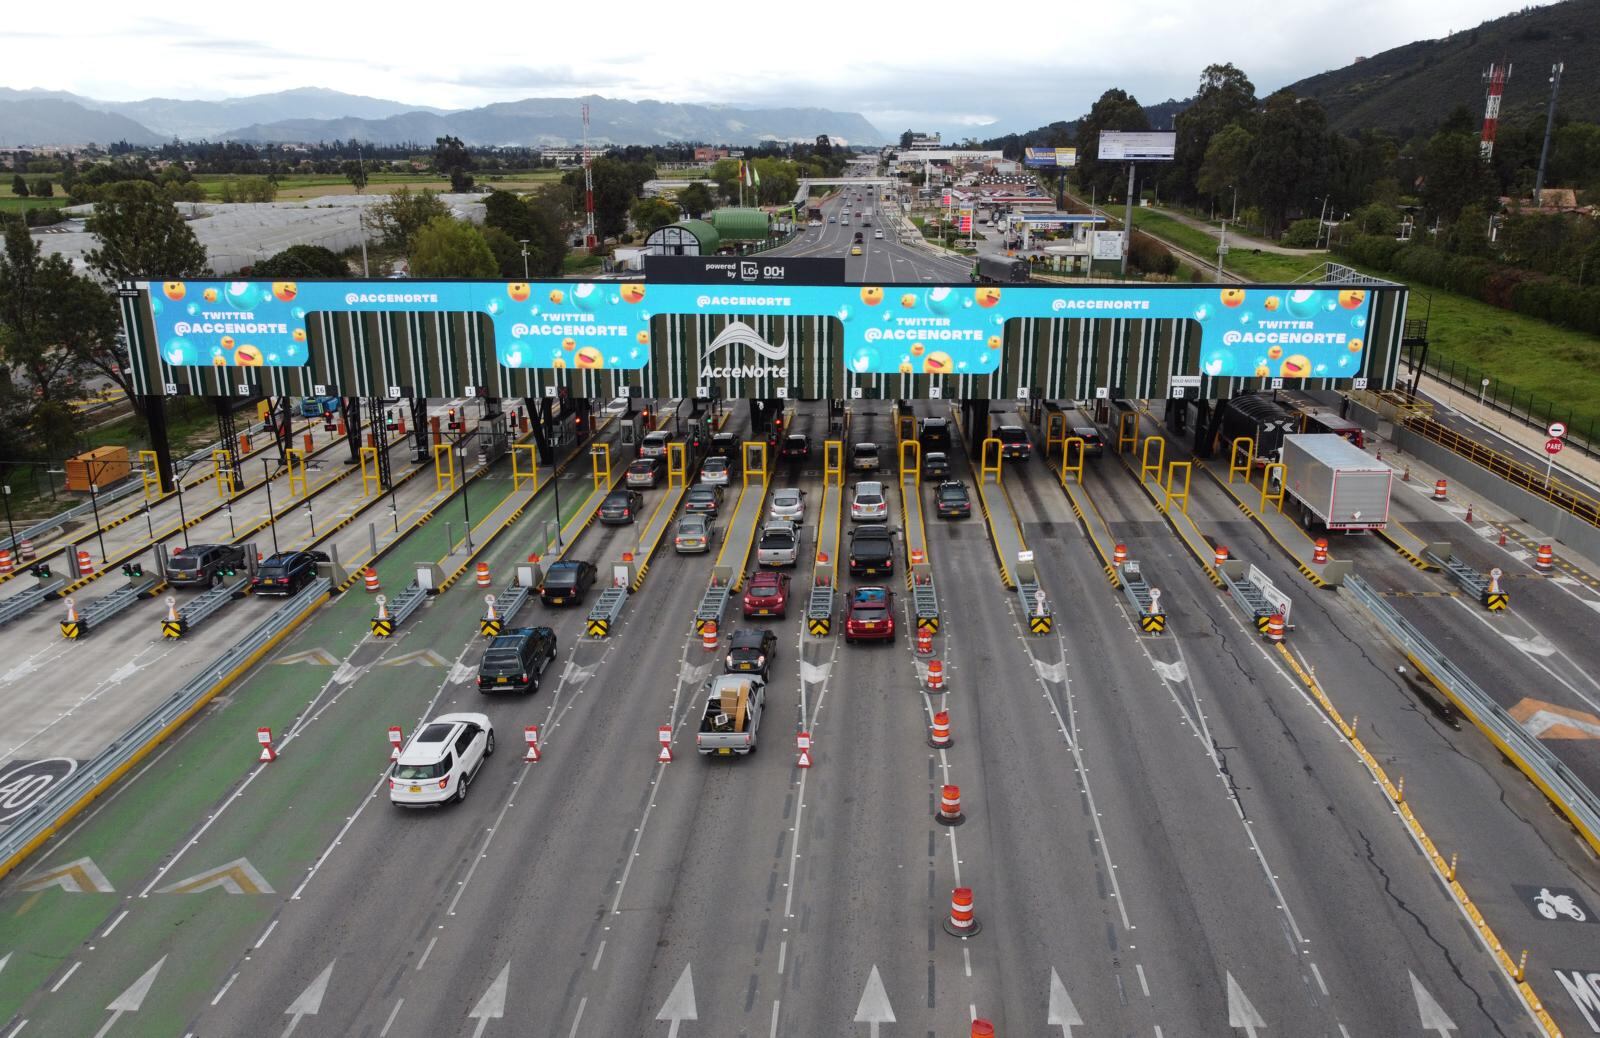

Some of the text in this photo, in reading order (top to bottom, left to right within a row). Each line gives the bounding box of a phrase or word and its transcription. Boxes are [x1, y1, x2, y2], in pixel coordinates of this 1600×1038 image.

[345, 293, 438, 304] @ACCENORTE
[696, 295, 791, 307] @ACCENORTE
[1052, 299, 1150, 311] @ACCENORTE
[202, 312, 254, 320] TWITTER
[541, 313, 595, 322] TWITTER
[896, 318, 951, 326] TWITTER
[174, 322, 287, 336] @ACCENORTE
[511, 323, 627, 338] @ACCENORTE
[1258, 320, 1314, 330] TWITTER
[864, 329, 983, 343] @ACCENORTE
[1222, 330, 1346, 346] @ACCENORTE
[700, 365, 789, 378] AcceNorte
